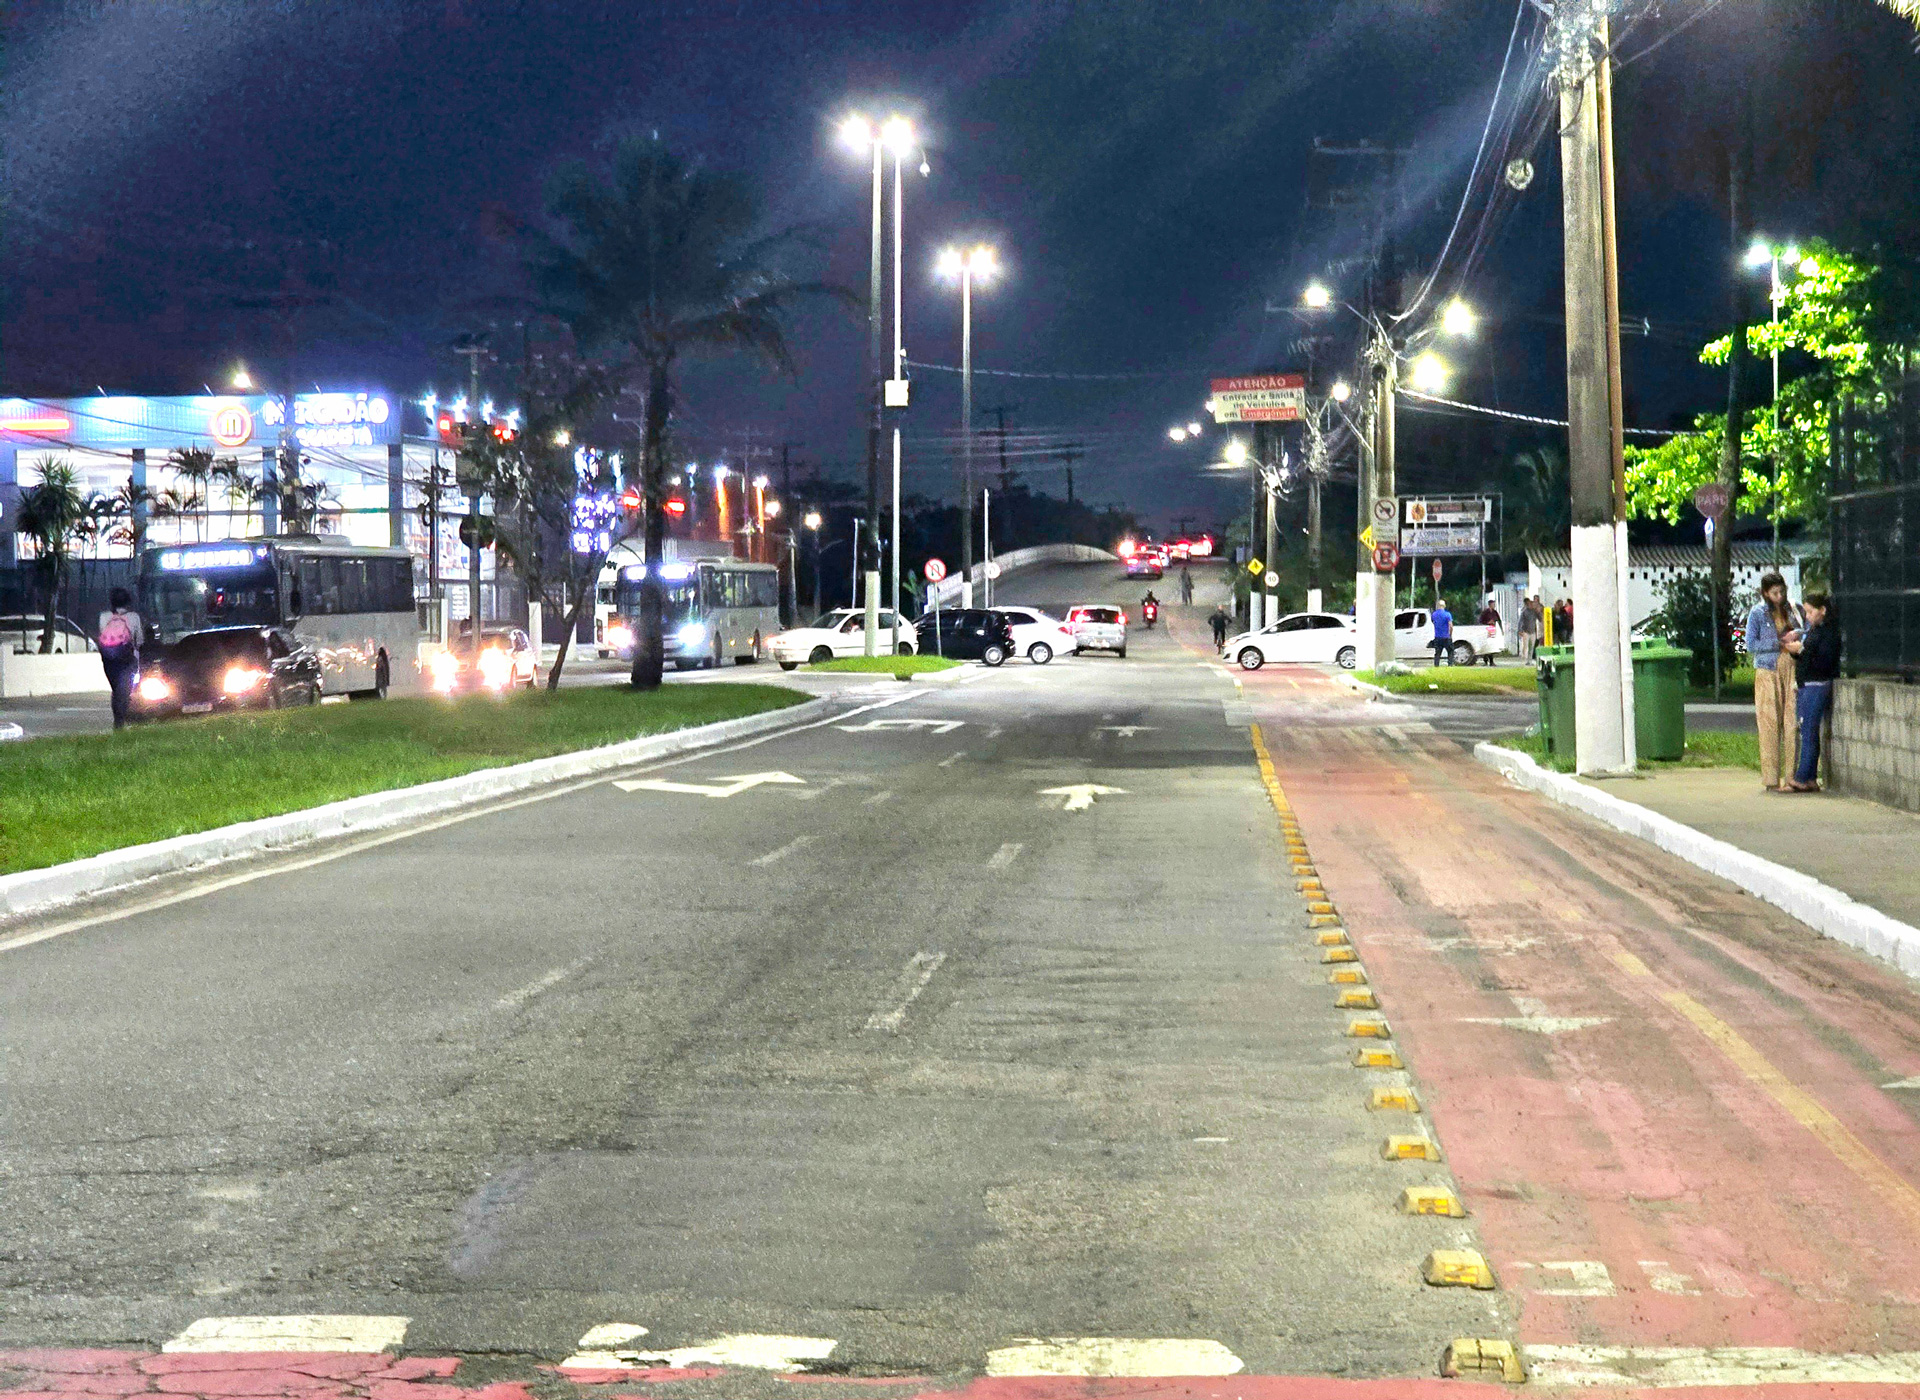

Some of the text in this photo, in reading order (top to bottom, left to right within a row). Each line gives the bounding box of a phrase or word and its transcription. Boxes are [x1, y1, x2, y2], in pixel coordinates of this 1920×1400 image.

[1229, 377, 1286, 390] ATENÇÃO
[1222, 393, 1258, 402] Entrada
[1224, 411, 1238, 419] em
[1698, 493, 1726, 506] PARE
